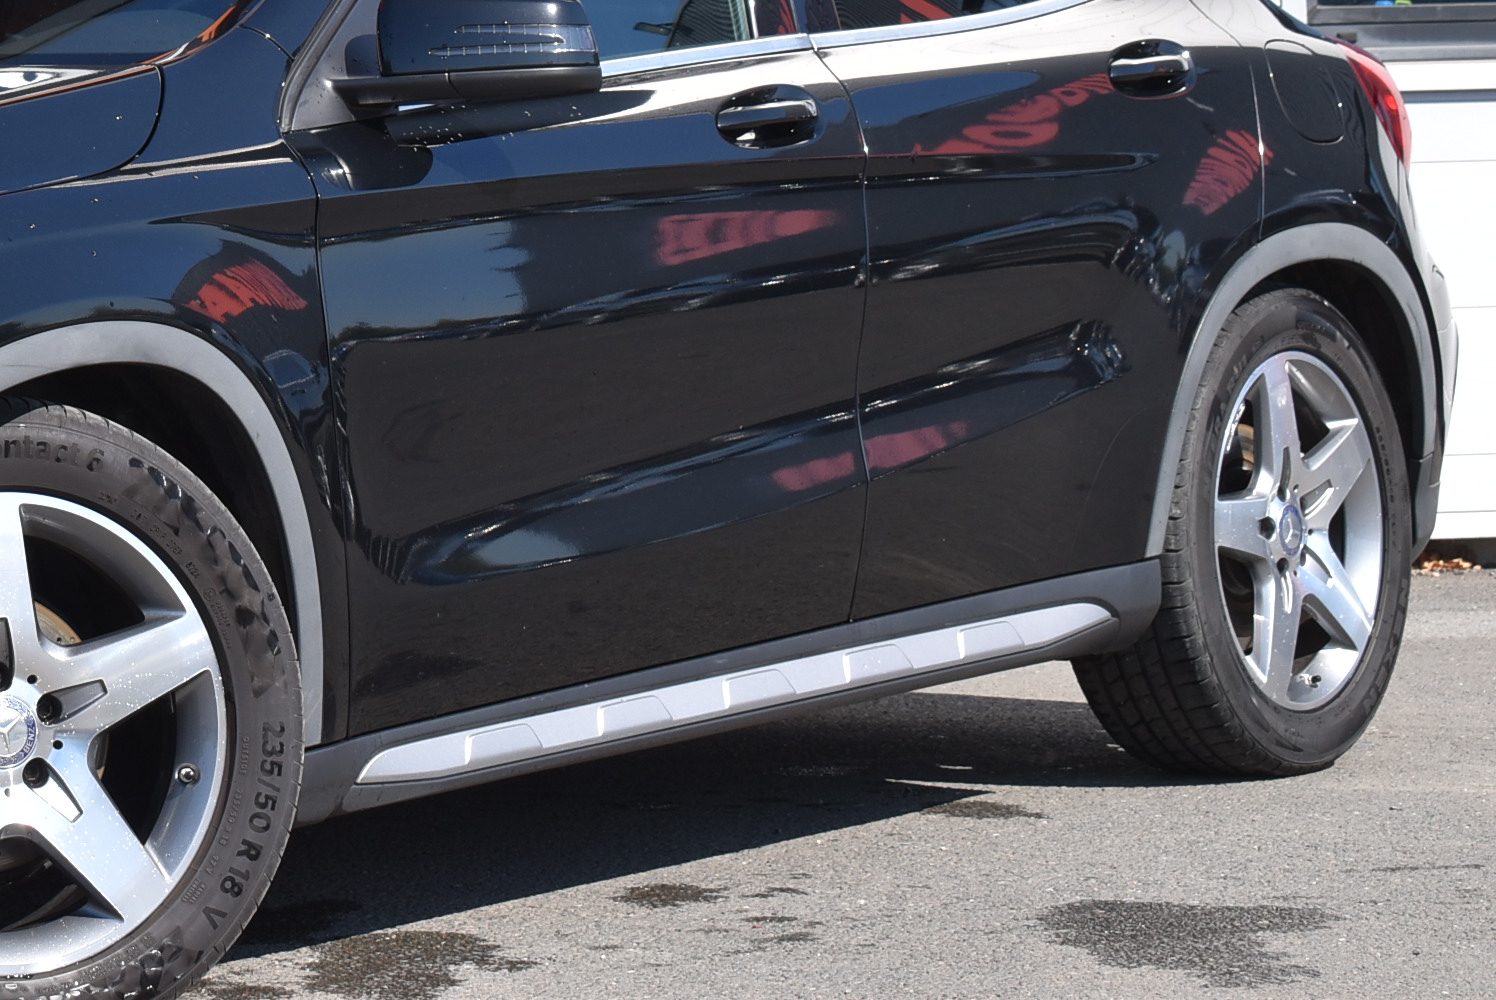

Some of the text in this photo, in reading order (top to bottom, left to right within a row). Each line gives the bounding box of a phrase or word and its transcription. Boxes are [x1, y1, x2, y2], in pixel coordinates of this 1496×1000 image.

[202, 720, 286, 931] 235/50 R 18 V
